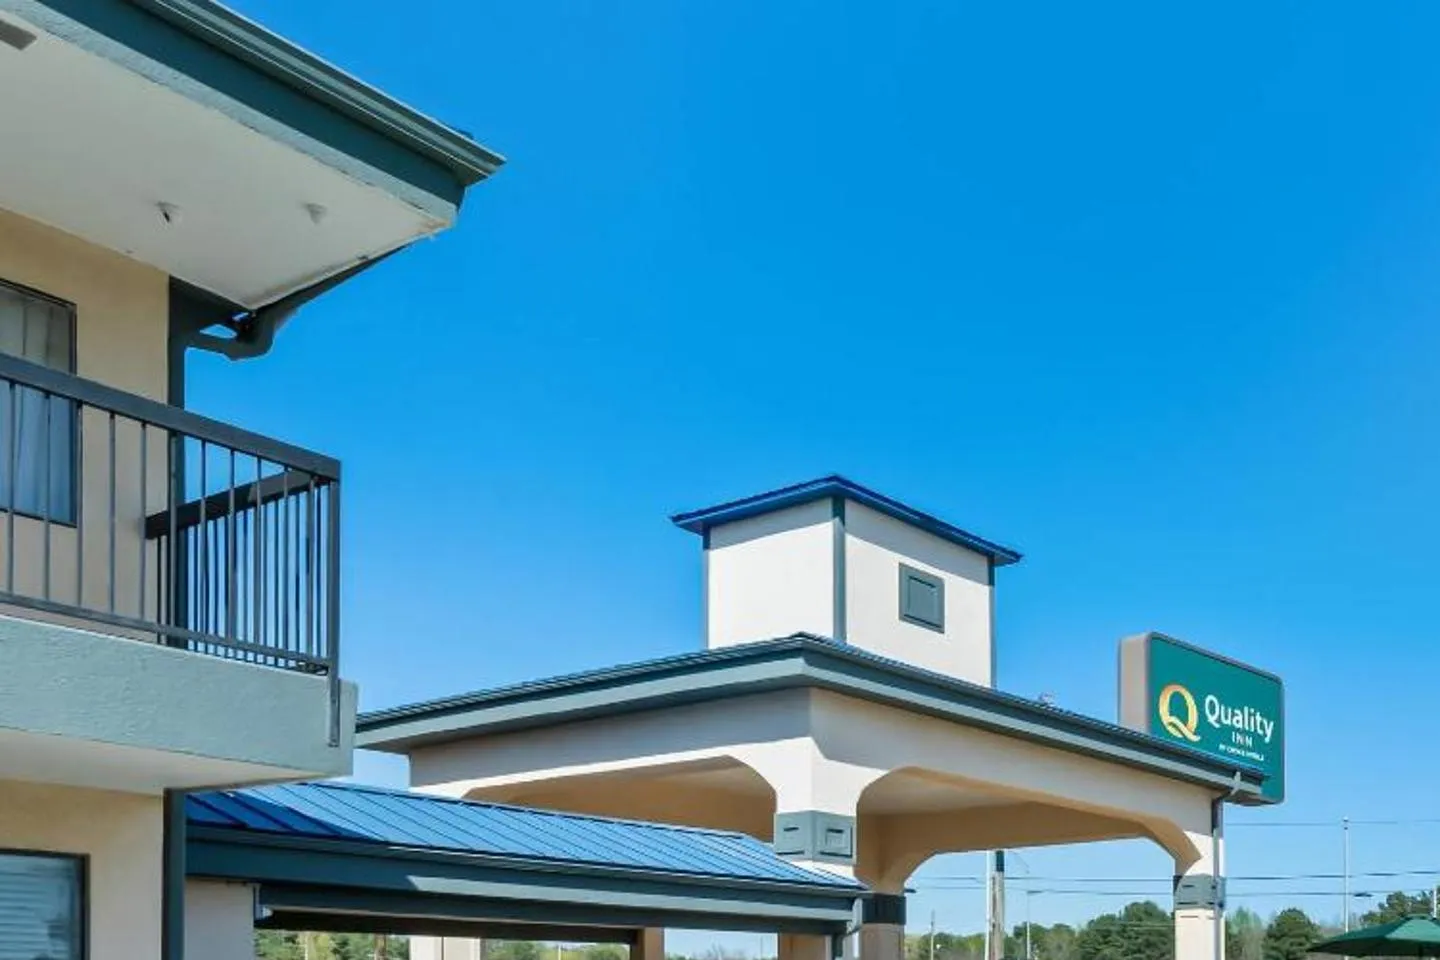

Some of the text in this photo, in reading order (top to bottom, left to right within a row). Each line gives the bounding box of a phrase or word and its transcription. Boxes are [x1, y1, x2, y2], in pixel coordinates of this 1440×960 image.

[1159, 685, 1200, 742] Q
[1205, 694, 1274, 743] Quality
[1232, 731, 1252, 747] INN
